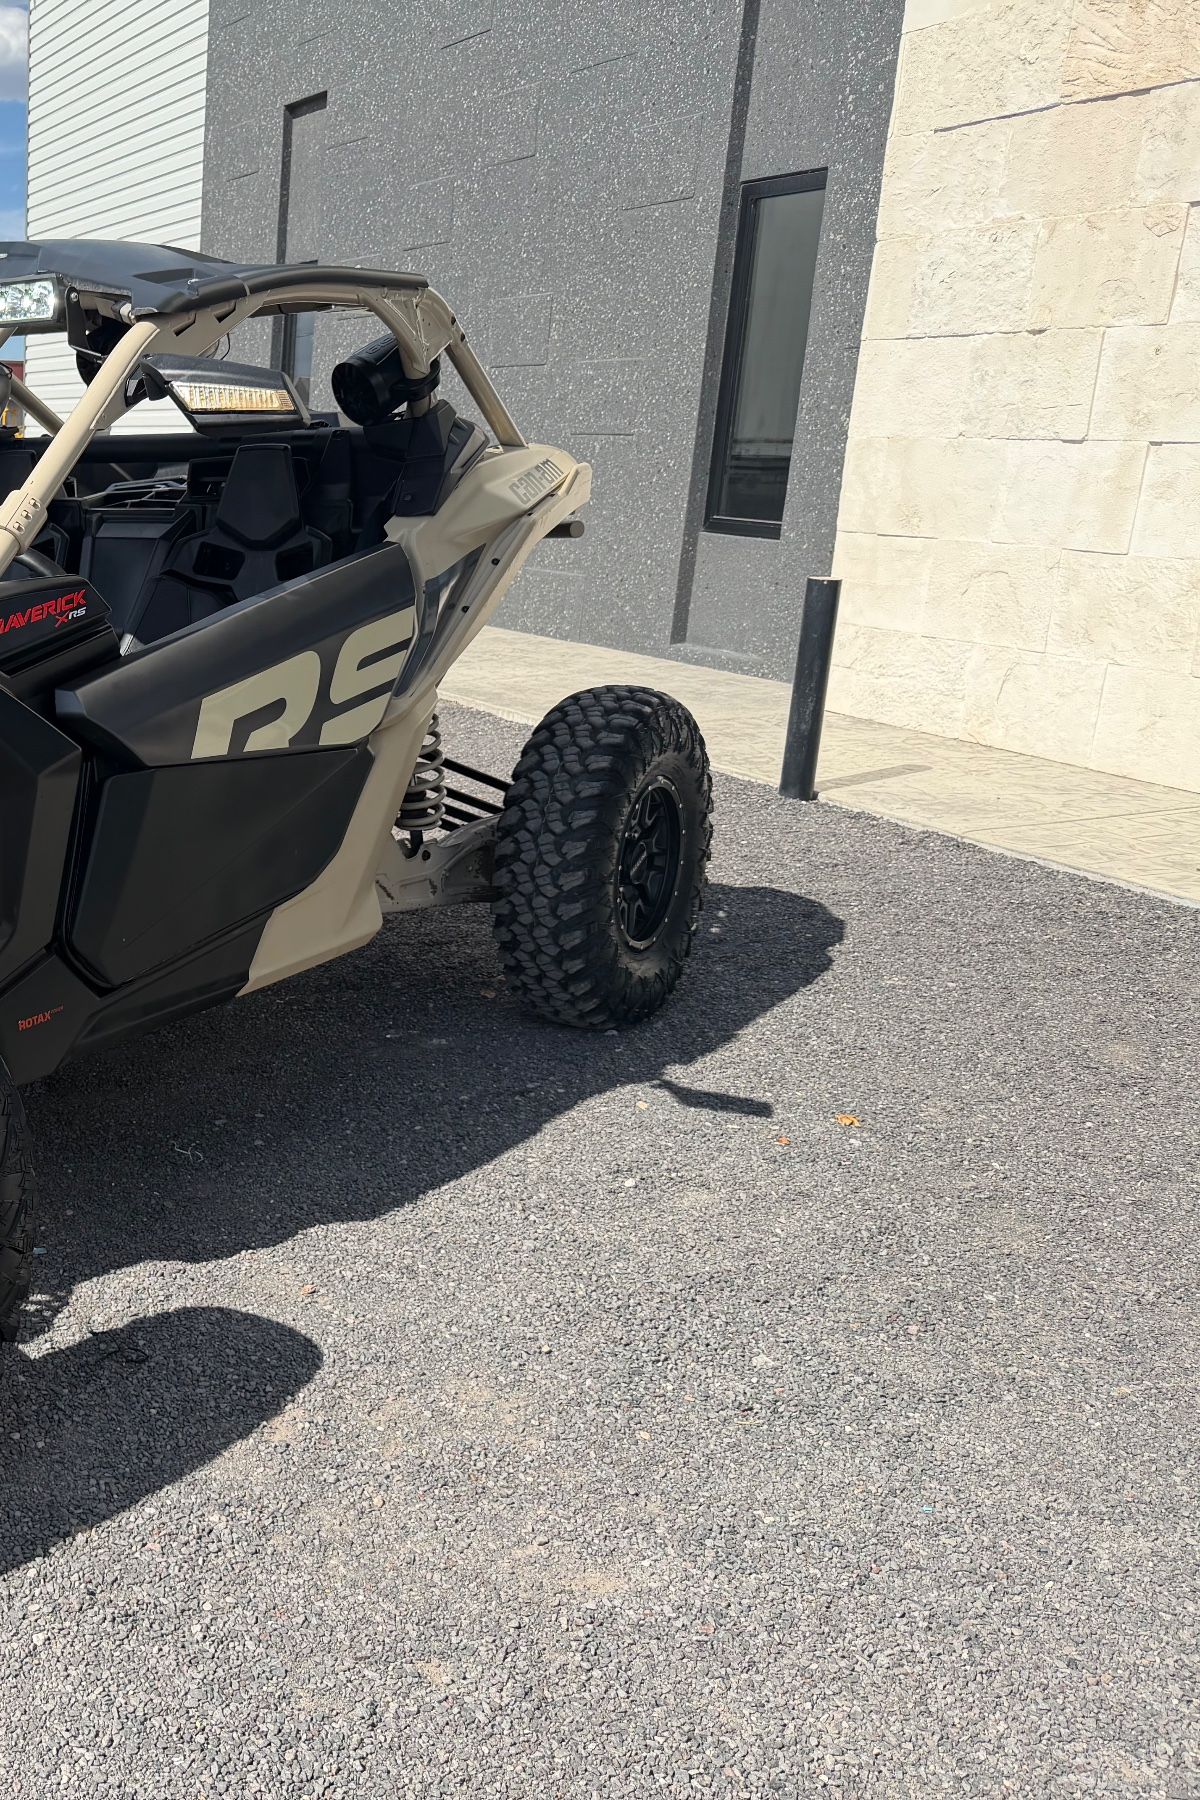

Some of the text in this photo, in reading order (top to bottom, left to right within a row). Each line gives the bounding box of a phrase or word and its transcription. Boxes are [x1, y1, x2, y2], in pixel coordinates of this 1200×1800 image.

[508, 458, 564, 505] can-am
[191, 605, 416, 760] RS
[18, 1010, 51, 1031] ROTAX
